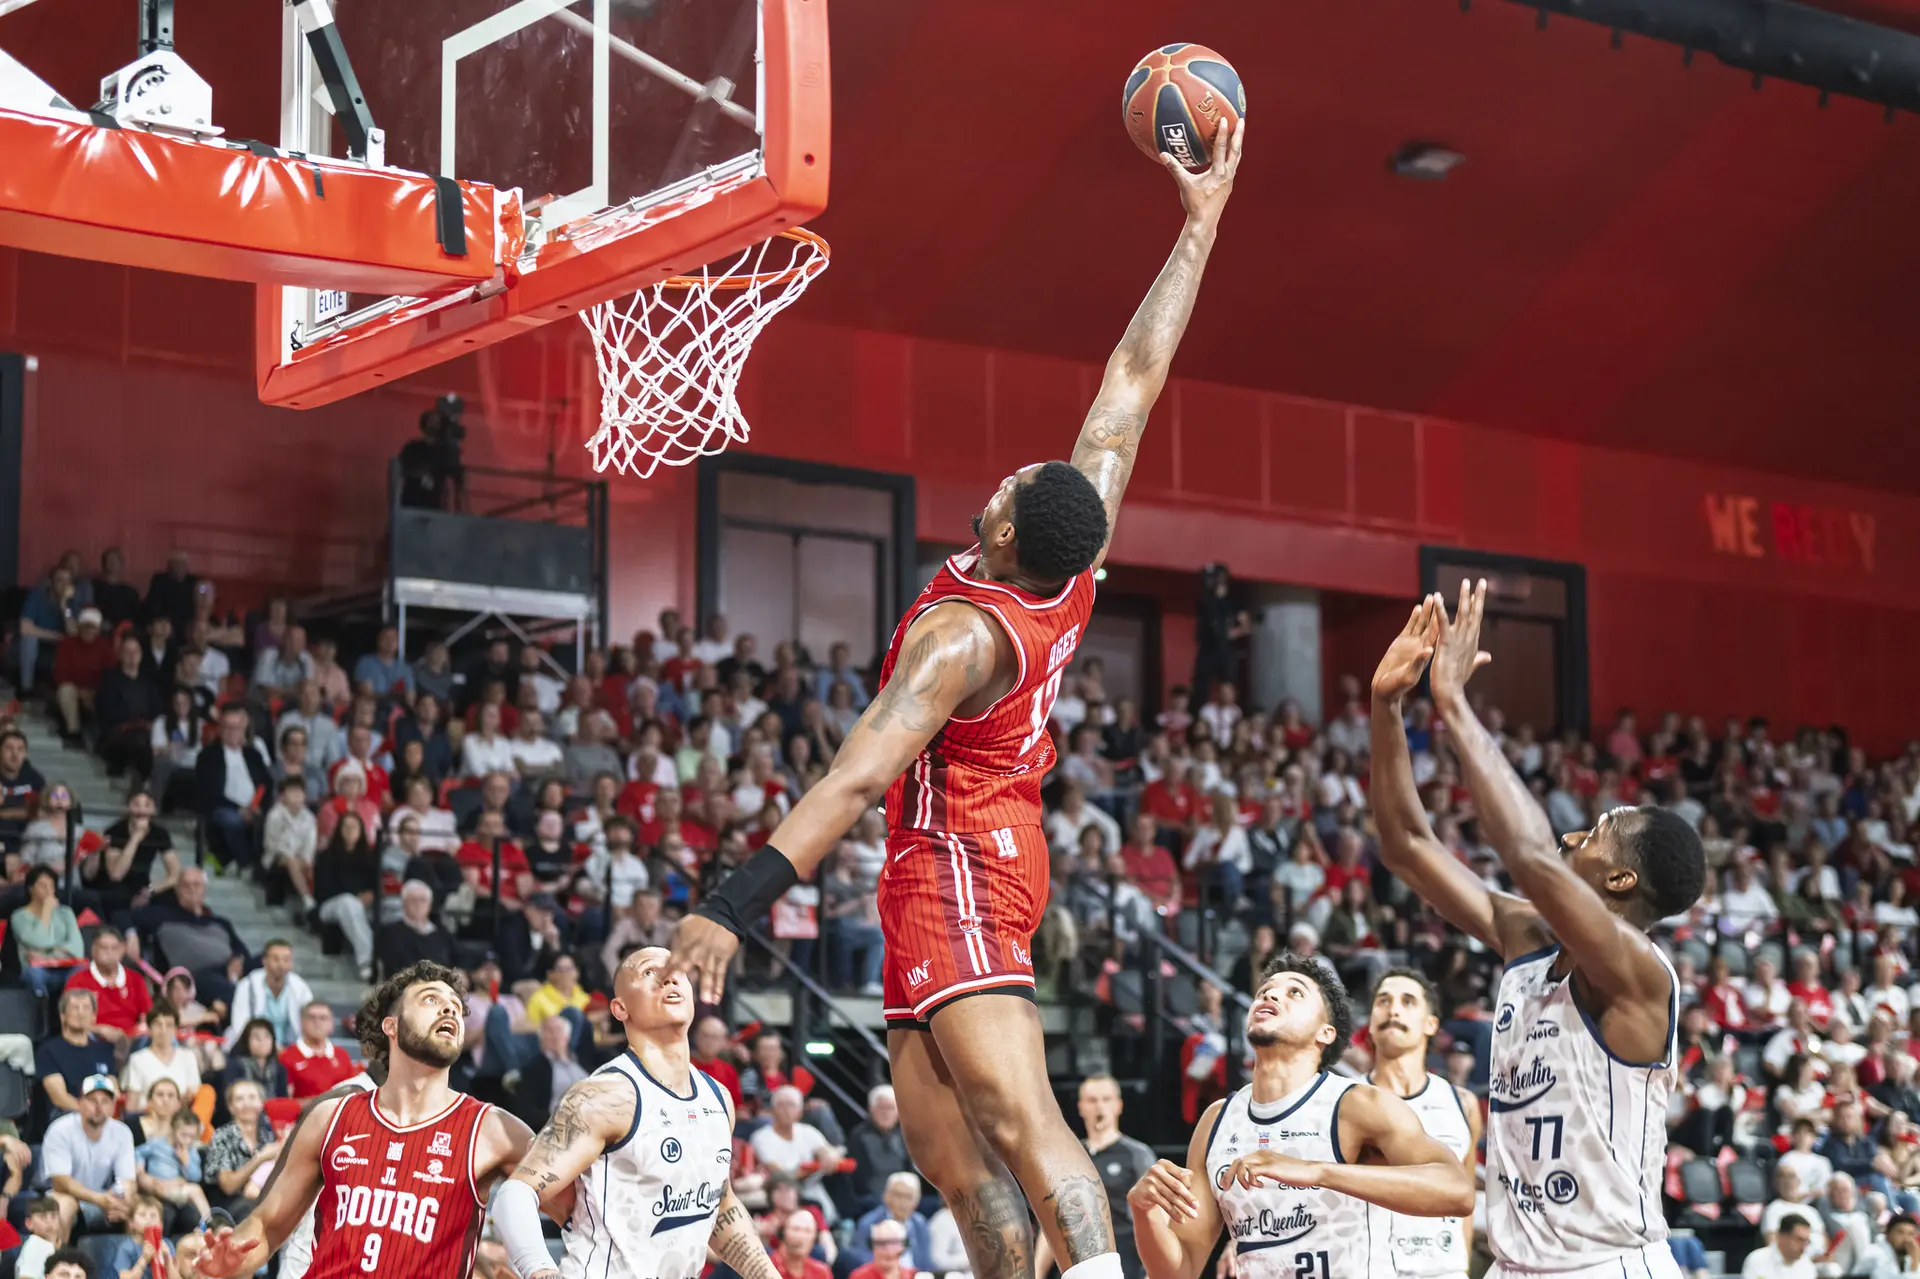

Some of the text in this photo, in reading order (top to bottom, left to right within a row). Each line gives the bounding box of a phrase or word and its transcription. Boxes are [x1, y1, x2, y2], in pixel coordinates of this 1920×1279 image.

[1704, 492, 1765, 558] WE
[1046, 623, 1080, 675] AGEE
[991, 827, 1018, 858] 12
[1525, 1115, 1564, 1161] 77
[381, 1166, 397, 1186] JL
[335, 1184, 440, 1244] BOURG
[361, 1233, 382, 1272] 9
[1294, 1250, 1331, 1279] 21
